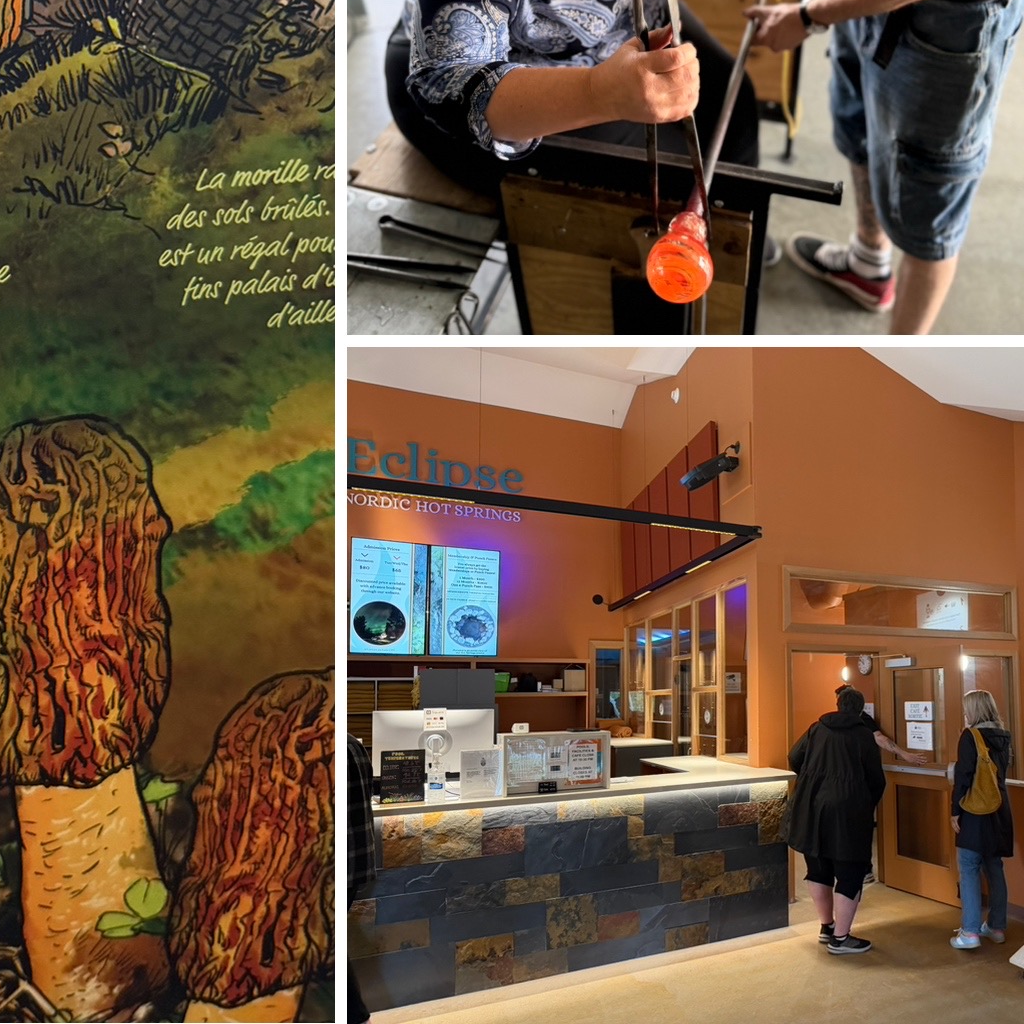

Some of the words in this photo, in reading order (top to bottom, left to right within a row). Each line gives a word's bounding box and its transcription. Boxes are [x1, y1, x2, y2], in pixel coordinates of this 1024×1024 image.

[195, 168, 226, 192] La
[231, 158, 310, 188] morille
[166, 202, 207, 230] des
[212, 199, 254, 226] sols
[260, 194, 330, 221] brûlés.
[159, 242, 194, 267] est
[197, 246, 224, 264] un
[230, 231, 294, 270] régal
[291, 236, 335, 263] pou
[182, 276, 223, 306] fins
[224, 269, 297, 305] palais
[347, 437, 524, 495] Eclipse
[347, 492, 411, 512] NORDIC
[415, 500, 452, 516] HOT
[454, 505, 522, 523] SPRINGS
